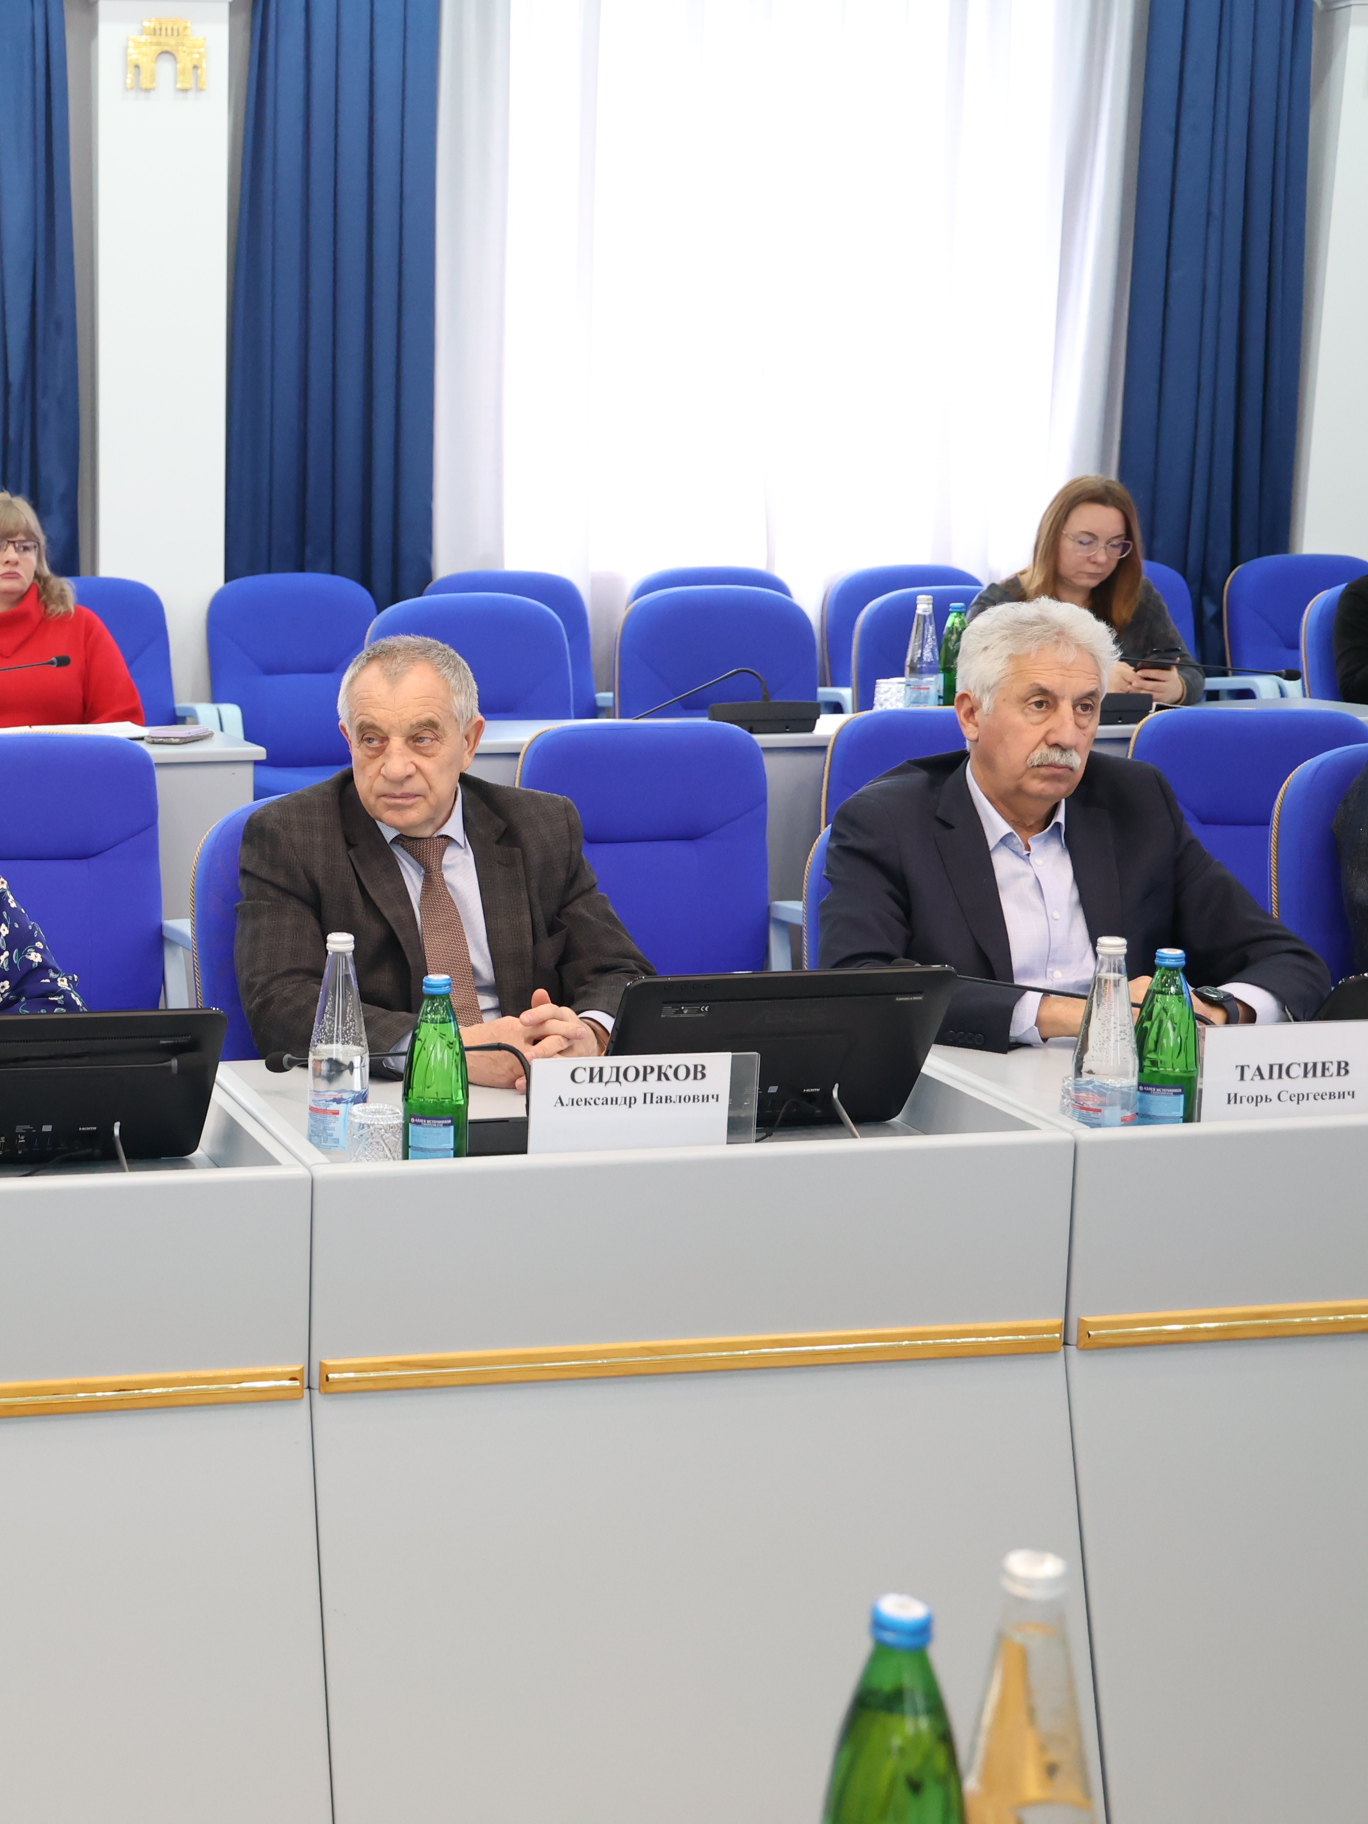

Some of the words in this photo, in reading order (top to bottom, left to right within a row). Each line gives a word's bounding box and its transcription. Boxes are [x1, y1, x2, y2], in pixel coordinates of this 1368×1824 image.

[570, 1063, 707, 1087] СИДОРКОВ
[1235, 1060, 1350, 1082] ТАПСИЕВ
[553, 1095, 637, 1109] Александр
[642, 1092, 720, 1105] Павлович
[1226, 1092, 1273, 1107] Игорь
[1277, 1090, 1356, 1106] Сергеевич
